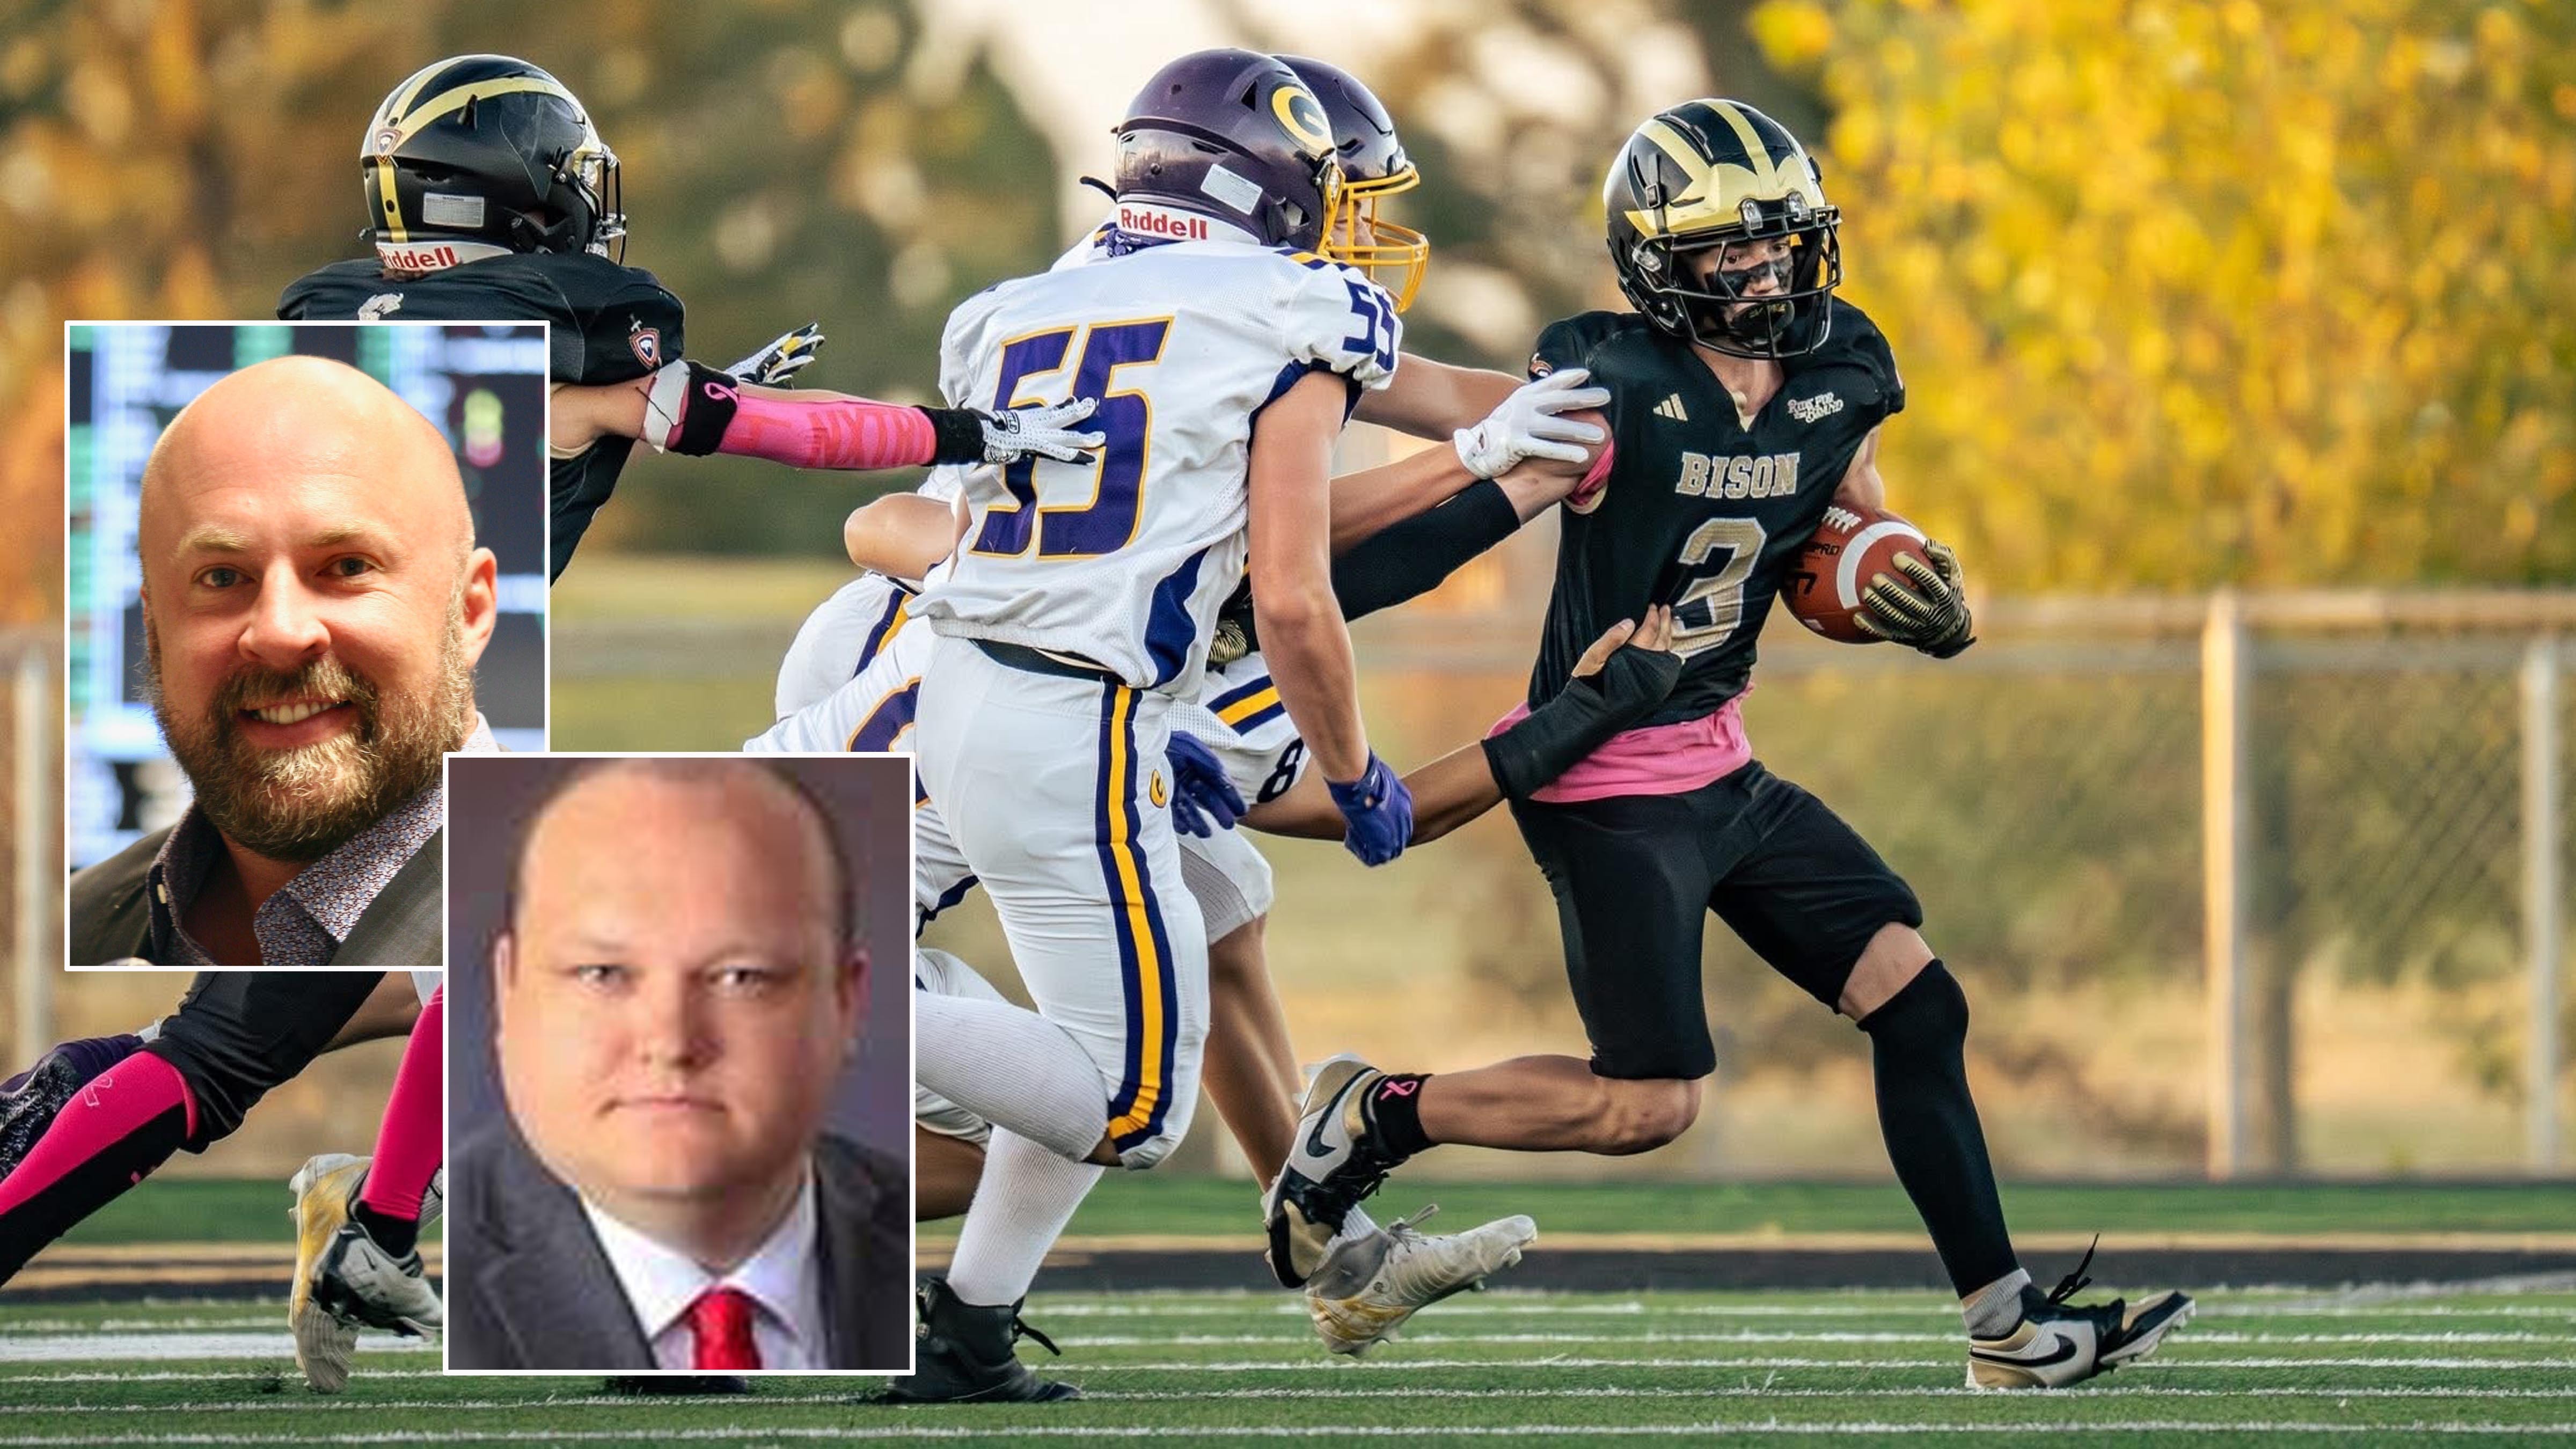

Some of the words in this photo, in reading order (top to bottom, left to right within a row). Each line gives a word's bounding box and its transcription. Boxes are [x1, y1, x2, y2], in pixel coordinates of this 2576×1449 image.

[1121, 208, 1207, 240] Riddell
[1342, 278, 1395, 371] 55
[968, 316, 1174, 561] 55
[1675, 451, 1800, 499] BISON
[1670, 517, 1767, 662] 3
[1257, 737, 1304, 803] 8
